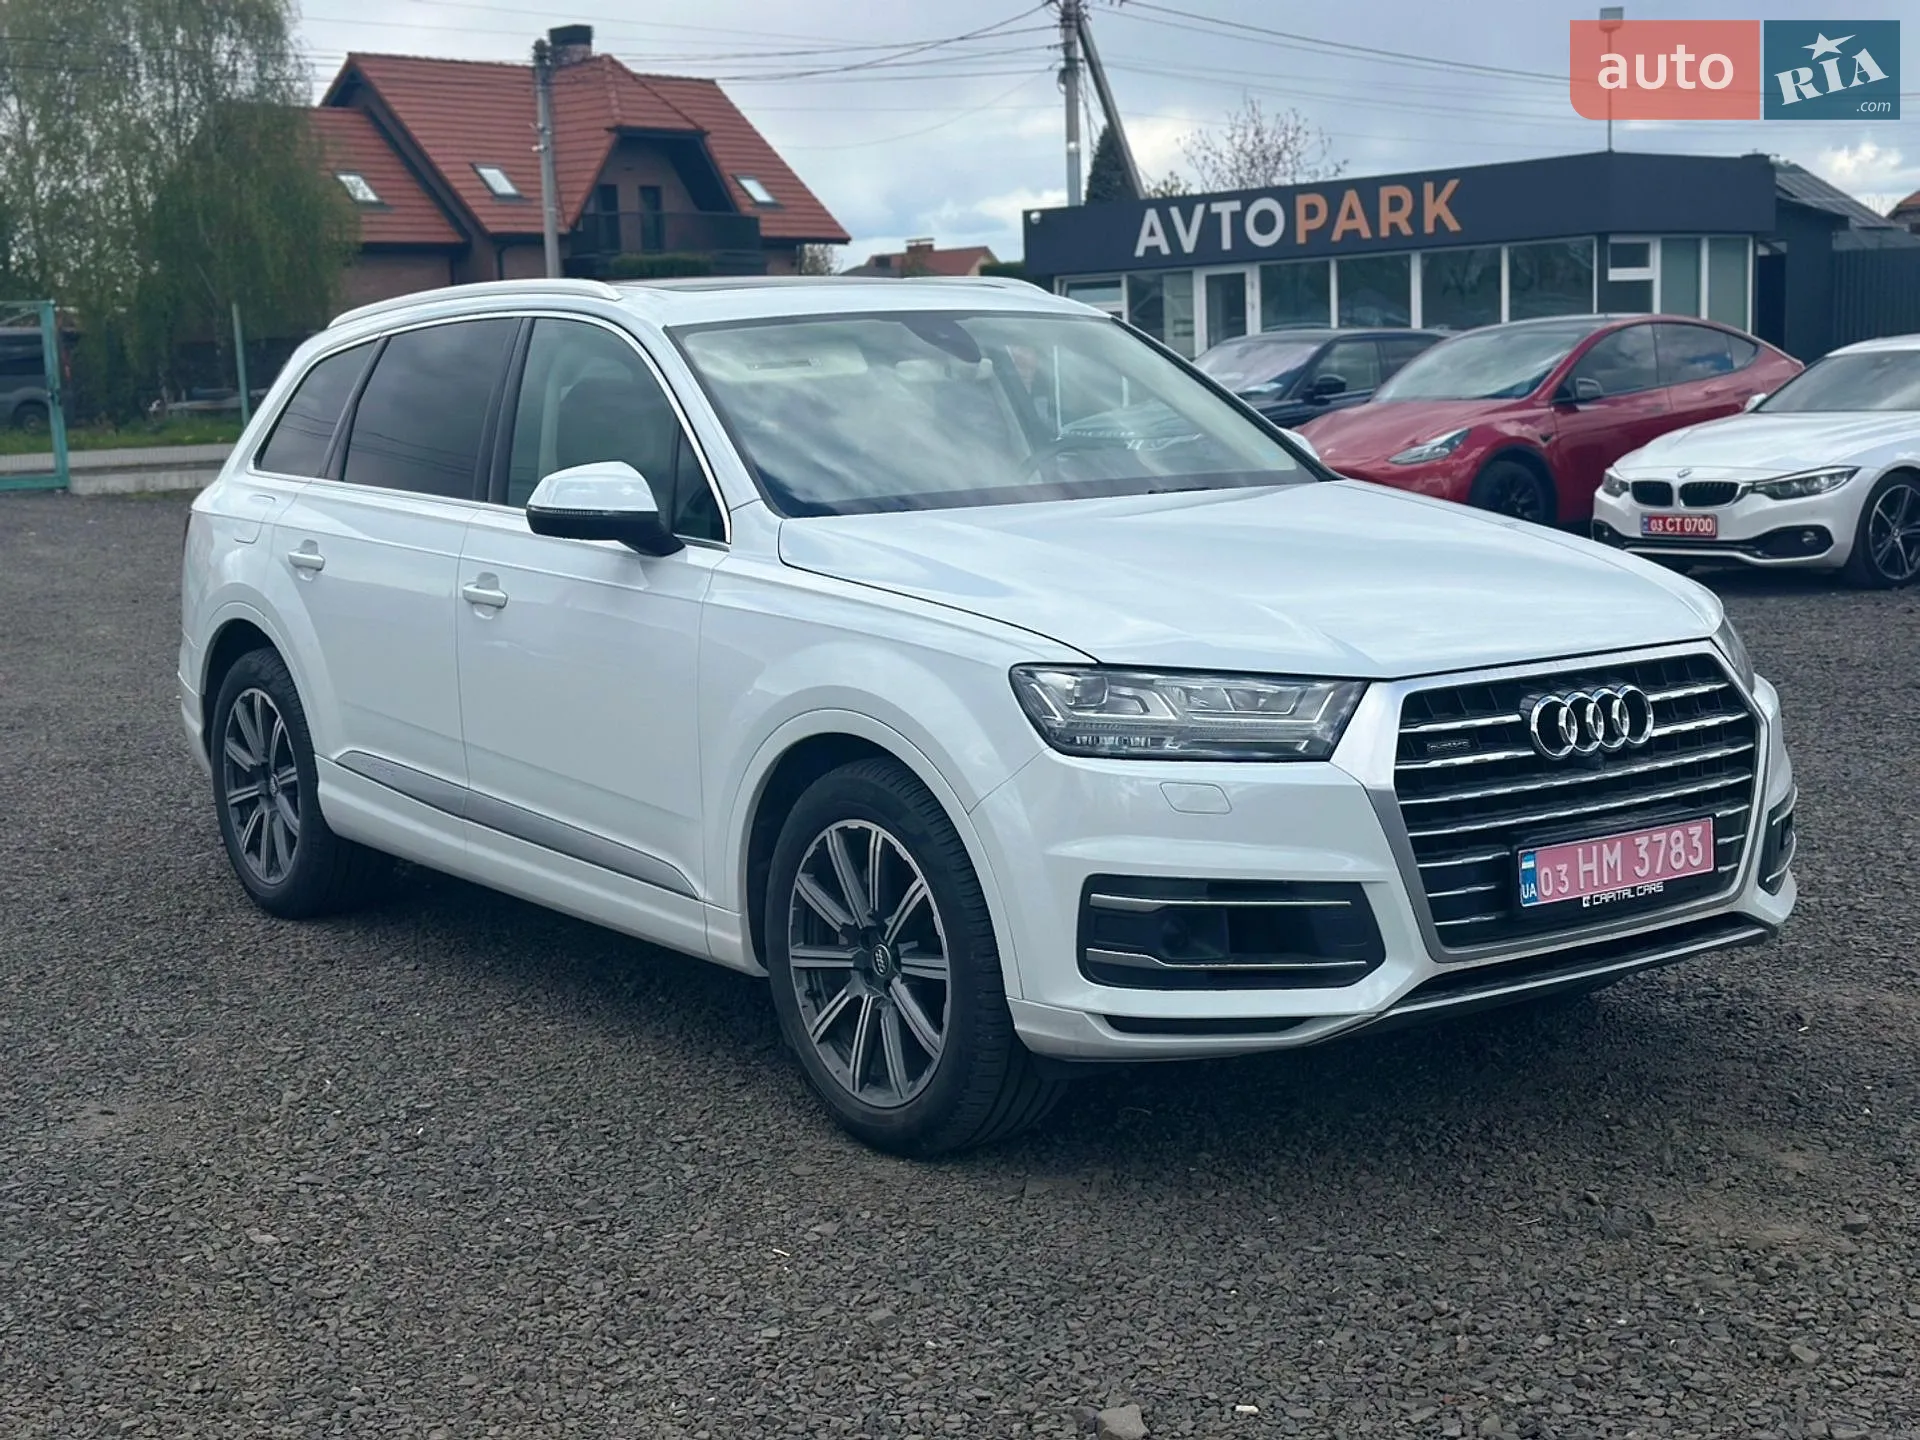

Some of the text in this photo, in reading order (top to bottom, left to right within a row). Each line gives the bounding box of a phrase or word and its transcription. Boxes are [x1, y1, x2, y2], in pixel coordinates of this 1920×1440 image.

[1650, 518, 1713, 532] 03 CT 0700
[1540, 825, 1703, 896] 03 HM 3783
[1522, 884, 1537, 899] UA
[1593, 882, 1664, 905] CAPITAL CARS
